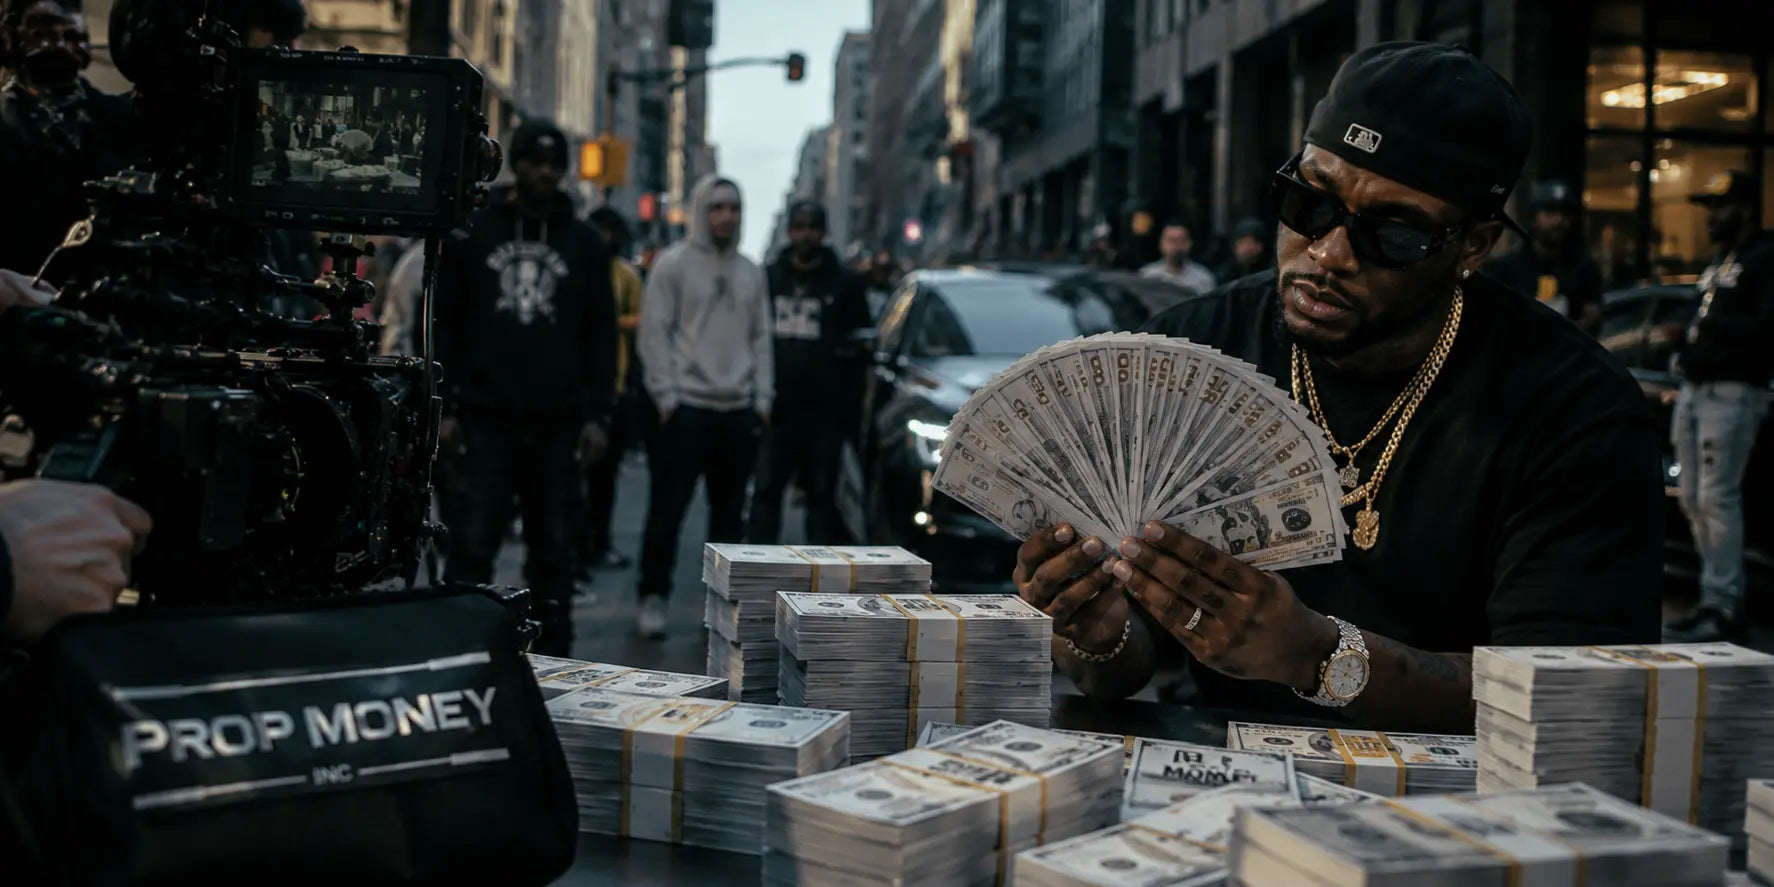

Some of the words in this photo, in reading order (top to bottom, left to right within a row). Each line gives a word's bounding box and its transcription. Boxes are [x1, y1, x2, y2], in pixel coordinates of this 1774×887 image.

[121, 710, 294, 771] PROP
[303, 687, 497, 748] MONEY
[312, 763, 354, 786] INC
